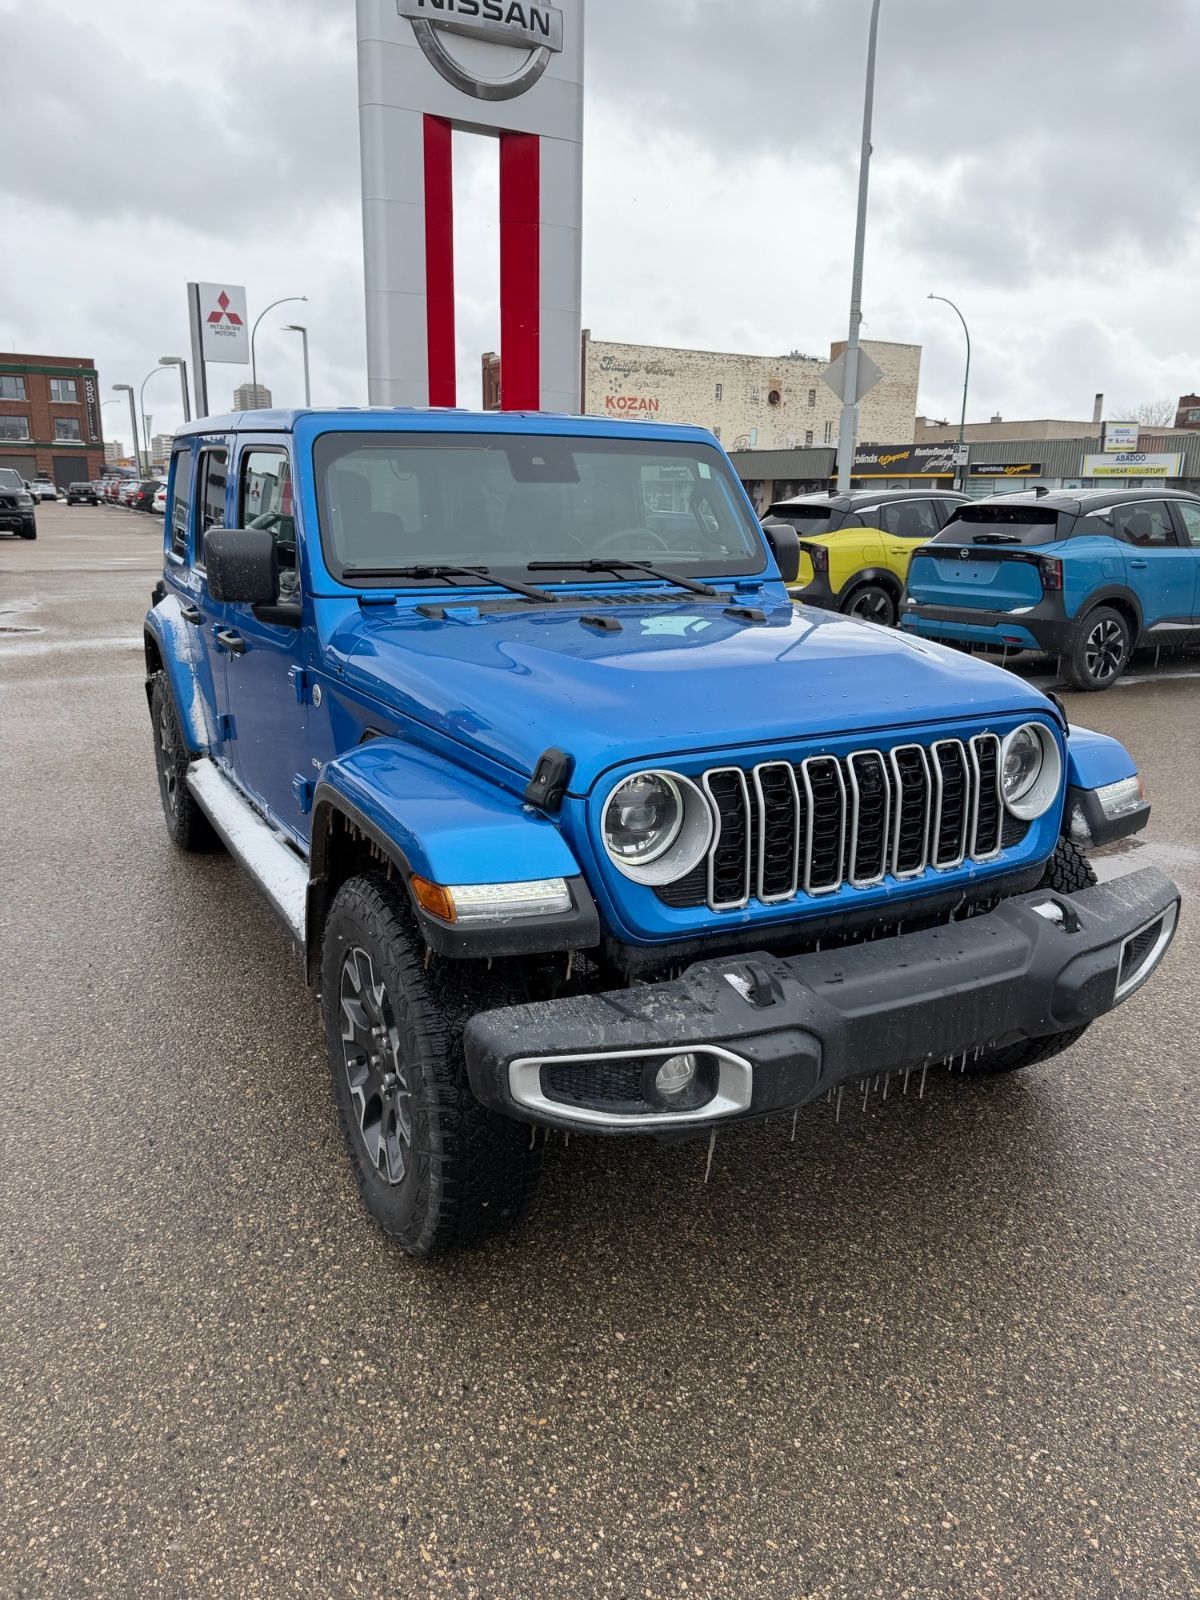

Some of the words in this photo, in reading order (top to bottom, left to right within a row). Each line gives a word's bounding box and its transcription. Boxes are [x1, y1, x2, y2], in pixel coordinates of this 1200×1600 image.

[605, 395, 660, 411] KOZAN
[914, 447, 953, 457] HunterDougla
[1115, 454, 1147, 462] ABADOO
